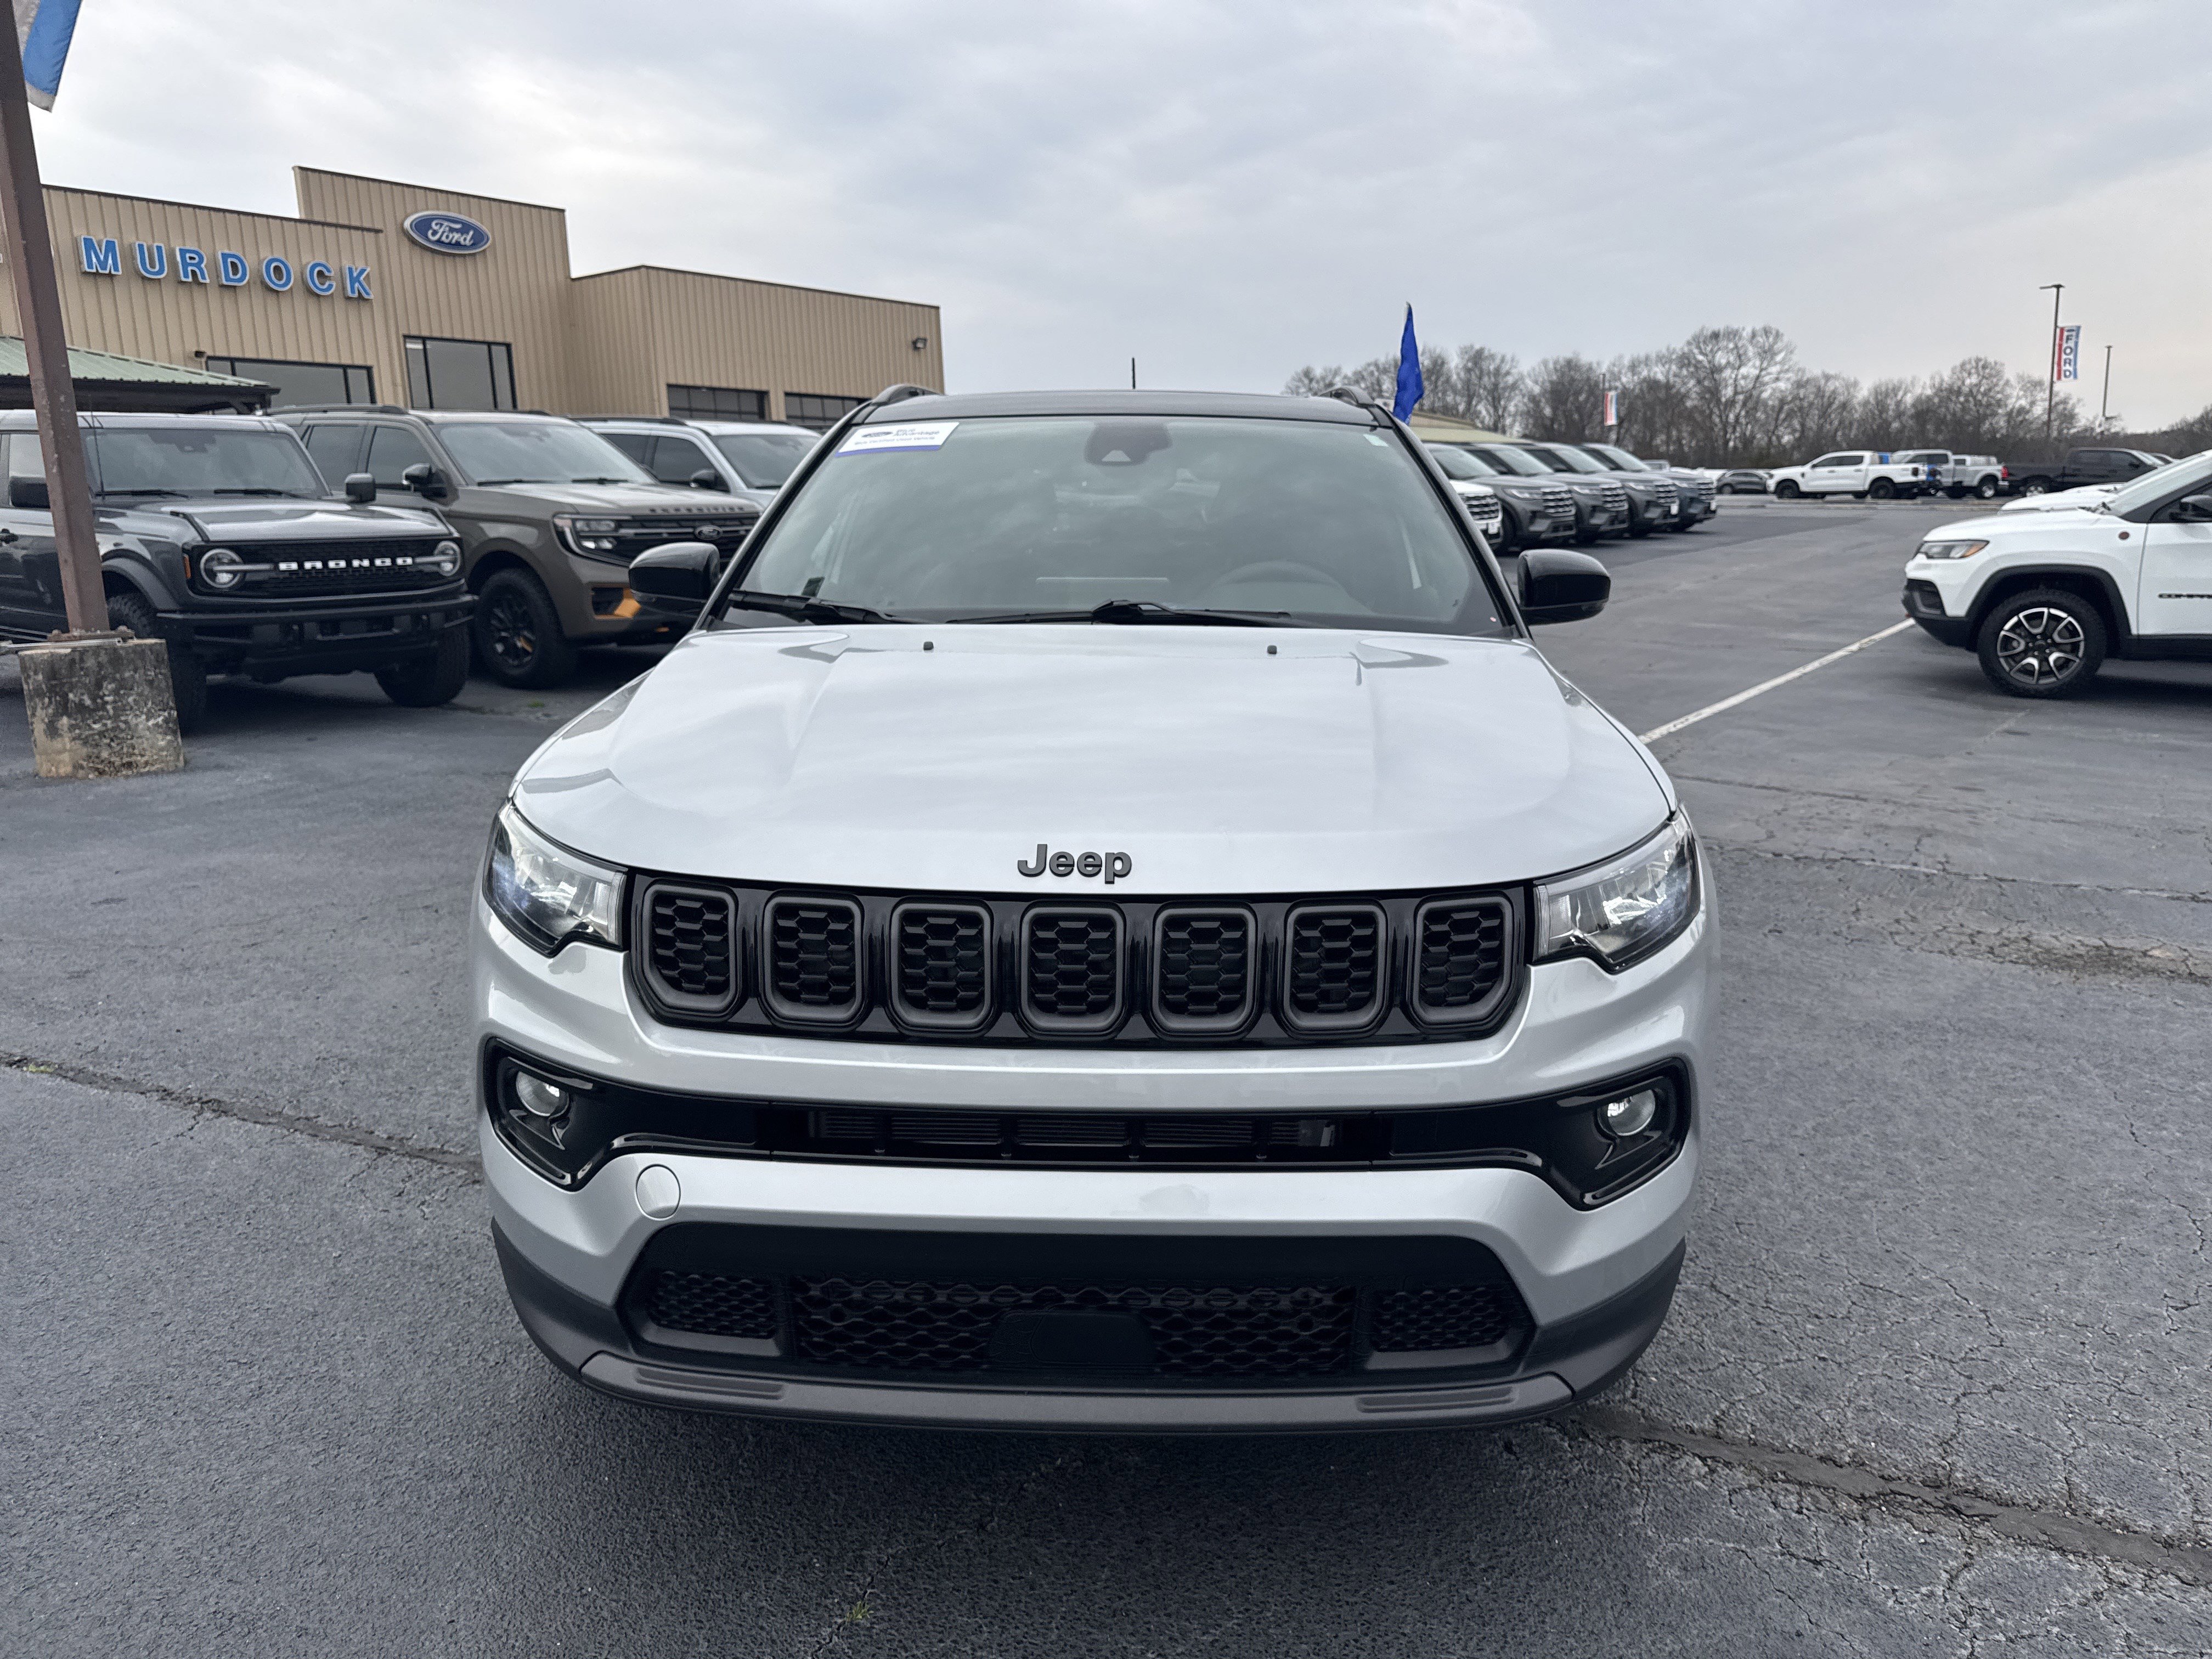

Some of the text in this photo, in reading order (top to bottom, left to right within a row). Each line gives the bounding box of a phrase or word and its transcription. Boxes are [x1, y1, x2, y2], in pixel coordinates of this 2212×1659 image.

[427, 219, 475, 246] Ford
[81, 235, 374, 300] MURDOCK
[2063, 334, 2073, 379] FORD
[278, 556, 413, 571] BRONCO
[1017, 843, 1132, 884] Jeep
